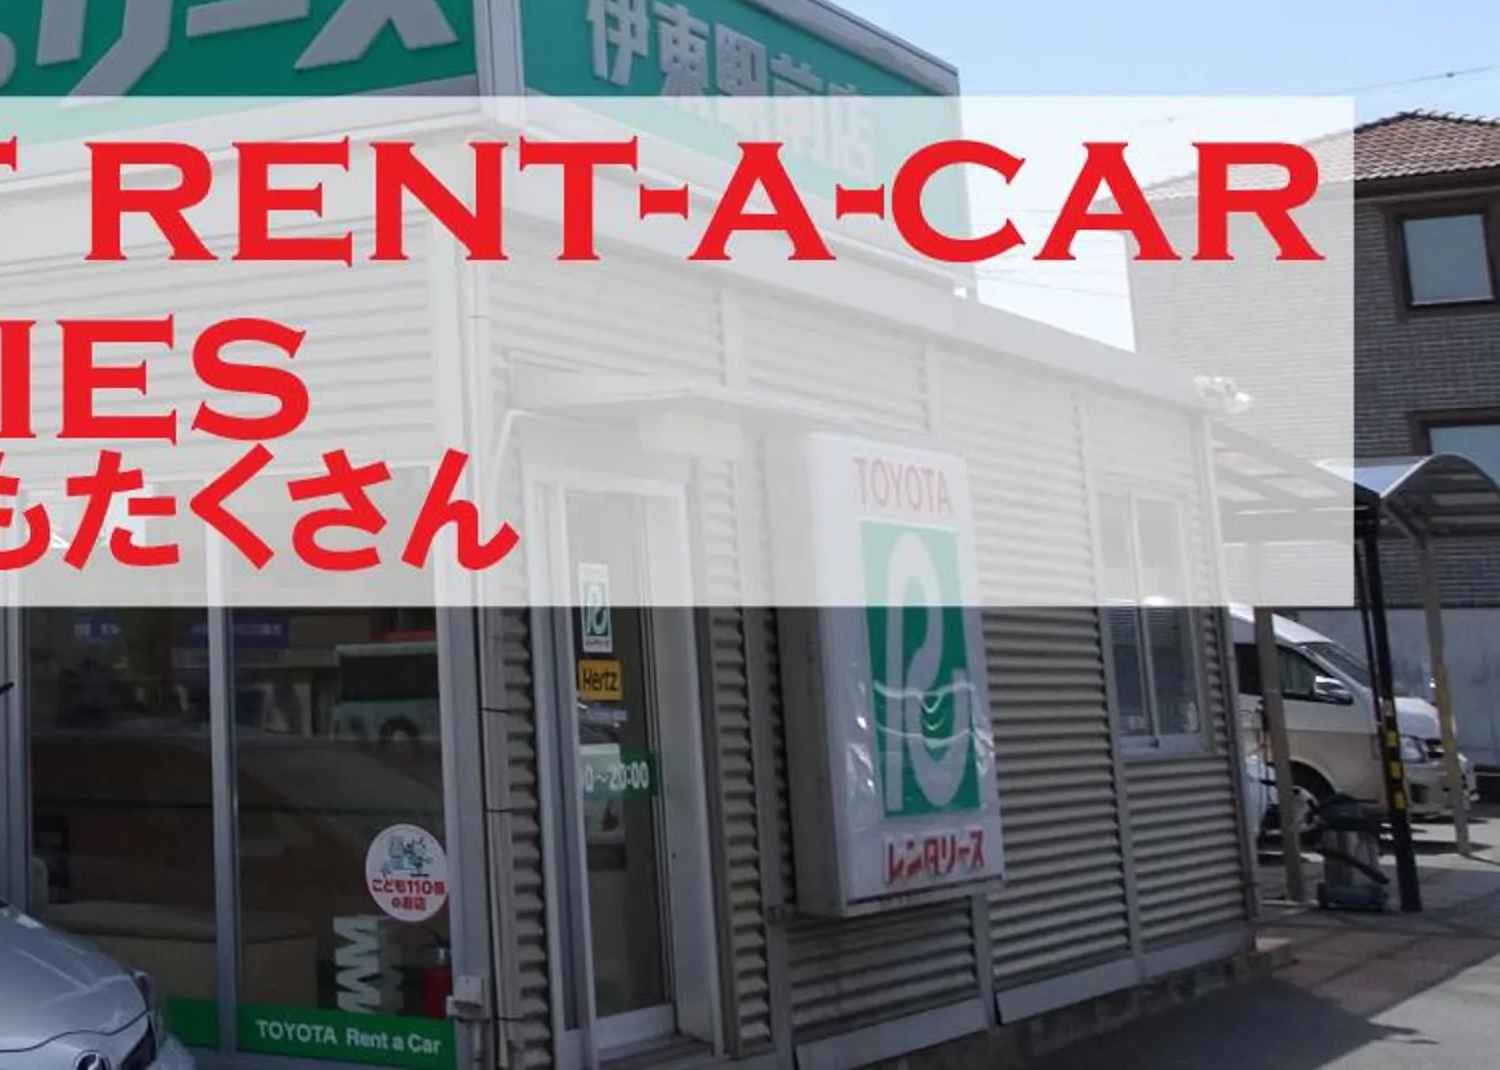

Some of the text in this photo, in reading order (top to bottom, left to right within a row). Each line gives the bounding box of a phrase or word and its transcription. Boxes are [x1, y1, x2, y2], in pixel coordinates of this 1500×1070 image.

[853, 456, 954, 516] TOYOTA
[581, 667, 620, 692] Hertz
[882, 828, 986, 885] レンタリース
[255, 1019, 442, 1055] TOYOTA Rent a Car
